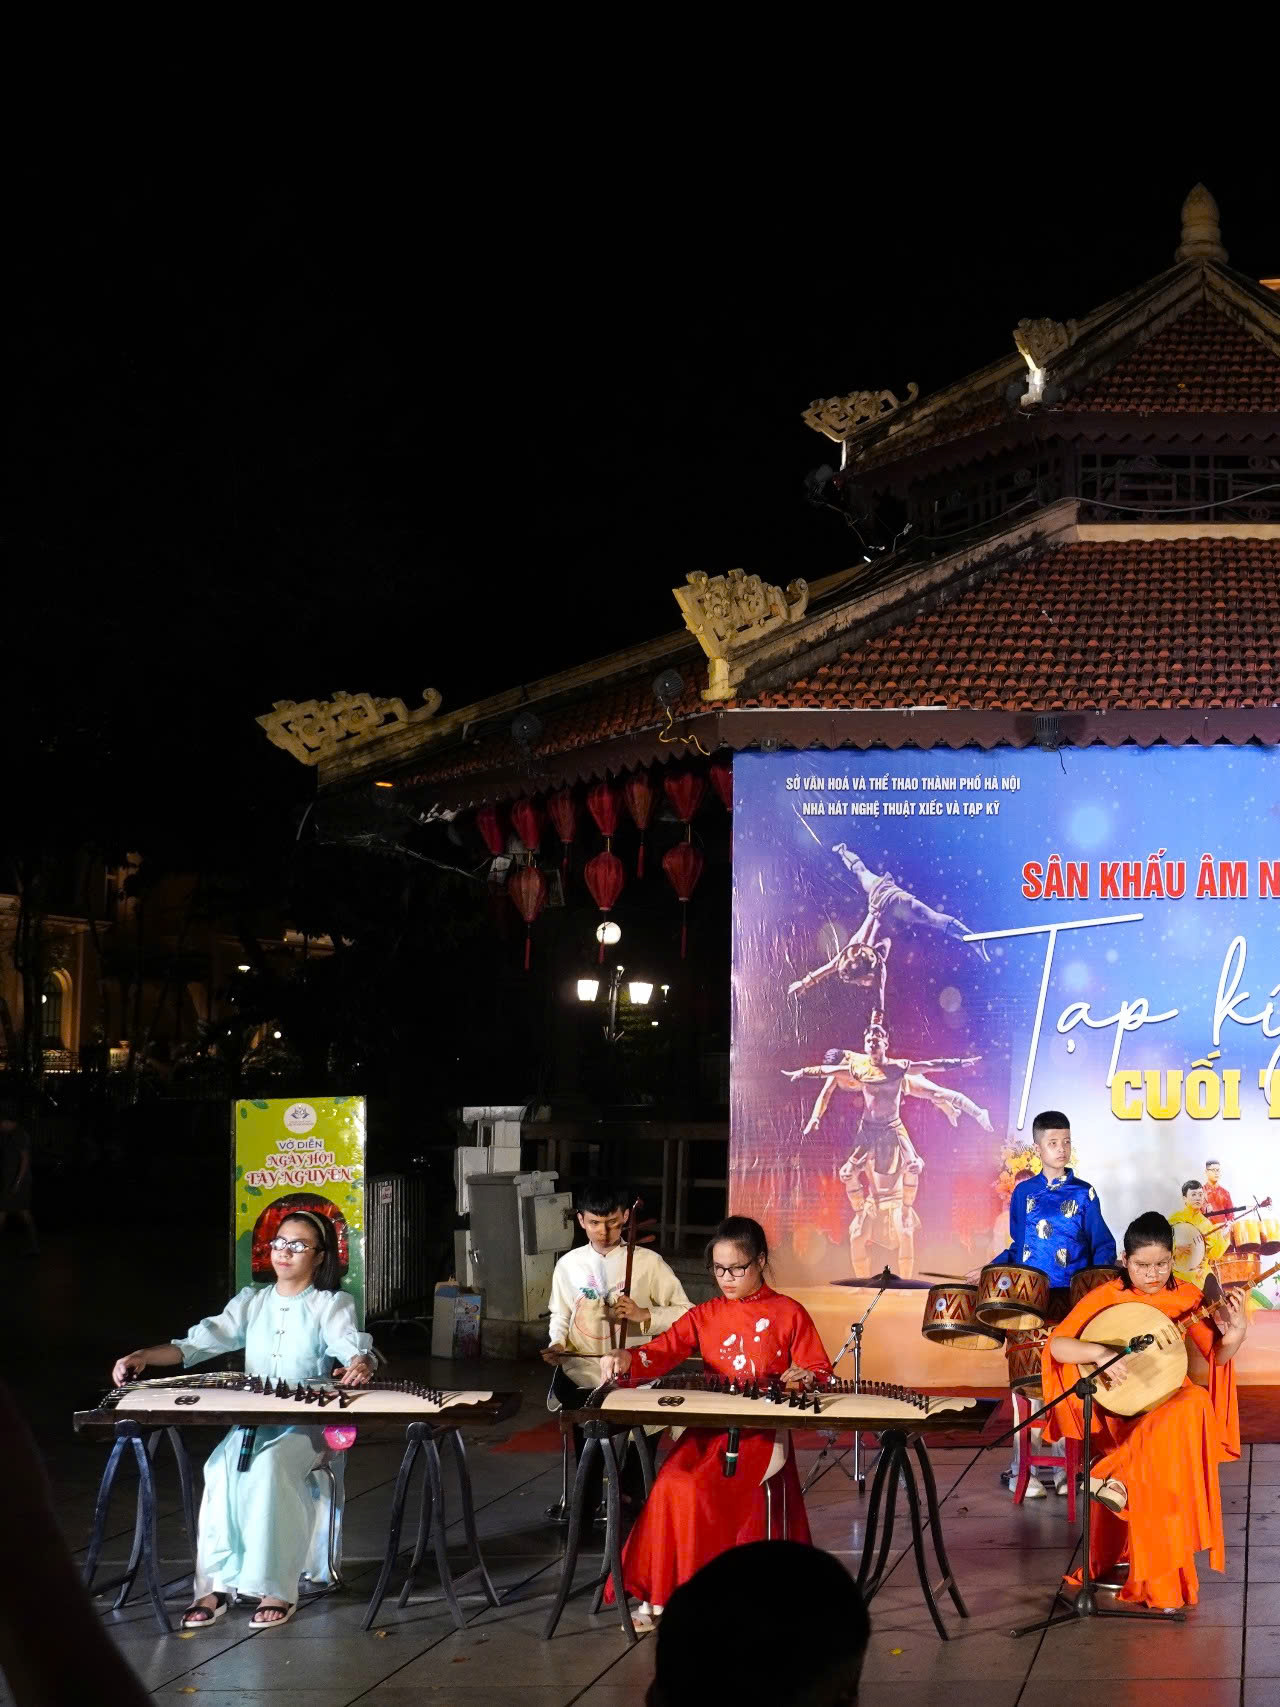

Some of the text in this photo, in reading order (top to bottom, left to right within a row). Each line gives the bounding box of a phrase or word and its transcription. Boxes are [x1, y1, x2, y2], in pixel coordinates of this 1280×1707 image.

[786, 773, 1020, 792] SỞ VĂN HOÁ VÀ THỂ THAO THÀNH PHỐ HÀ NỘI
[802, 799, 1000, 818] NHÀ HÁT NGHỆ THUẬT XIẾC VÀ TẠP KỸ
[1022, 854, 1089, 899] SÂN
[1100, 847, 1186, 899] KHẤU
[1196, 853, 1247, 899] ÂM
[963, 913, 1178, 1130] Tạp
[1111, 1050, 1241, 1120] CUỐI
[297, 1138, 322, 1149] DIỄN
[307, 1152, 333, 1166] HỘI
[247, 1166, 352, 1187] TÂY NGUYÊN
